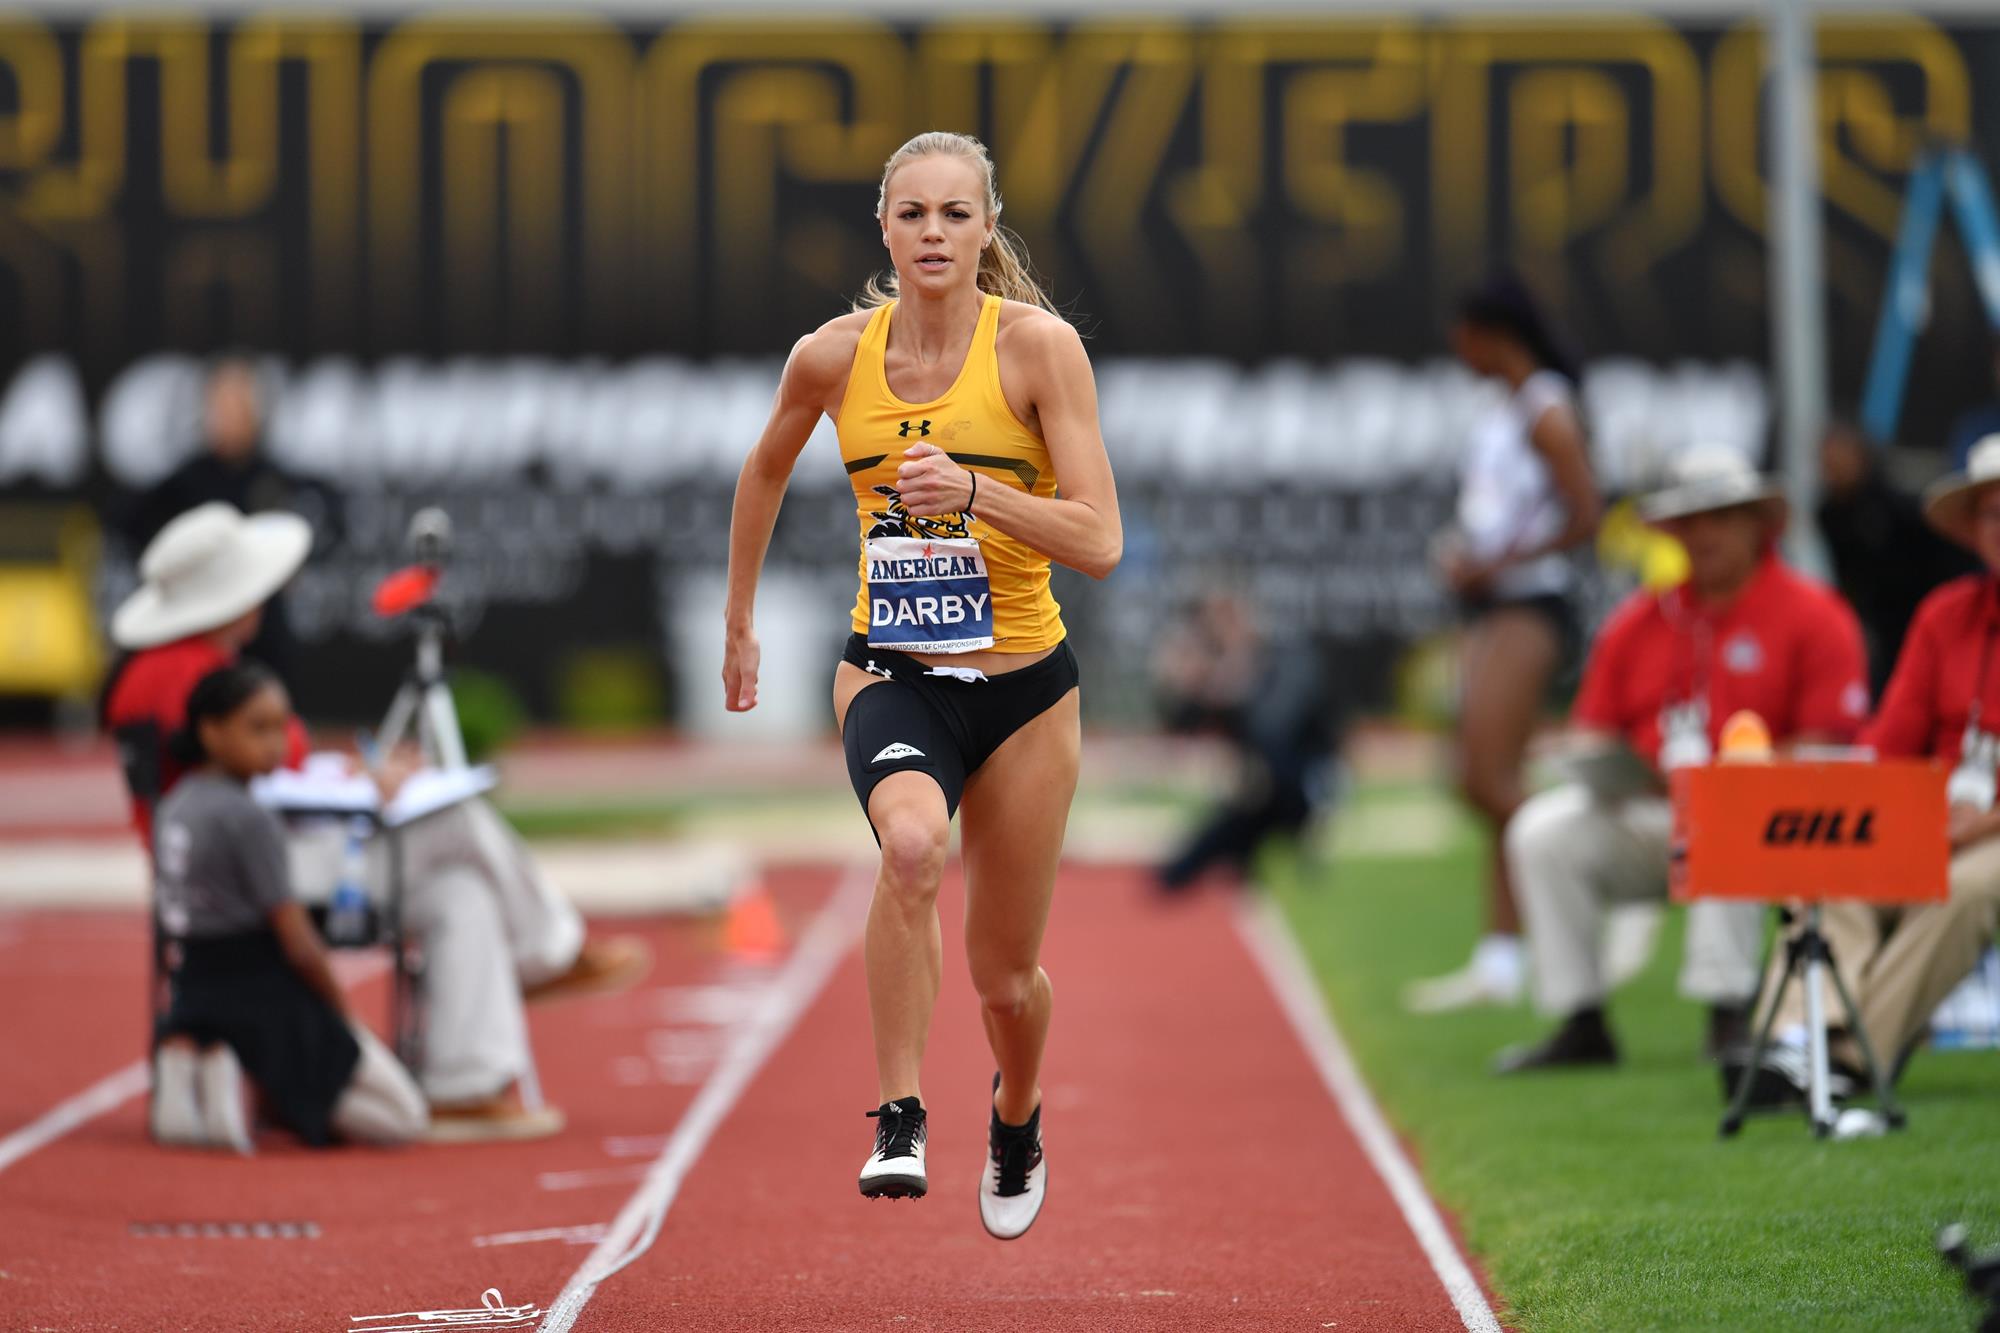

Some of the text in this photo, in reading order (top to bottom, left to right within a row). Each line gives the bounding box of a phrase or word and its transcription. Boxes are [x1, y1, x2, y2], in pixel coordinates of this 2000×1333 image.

[871, 556, 978, 579] AMERICAN
[872, 593, 988, 627] DARBY
[891, 643, 919, 651] OUTDOOR
[921, 643, 932, 651] T&F
[933, 640, 983, 650] CHAMPIONSHIPS
[1764, 810, 1874, 844] GILL
